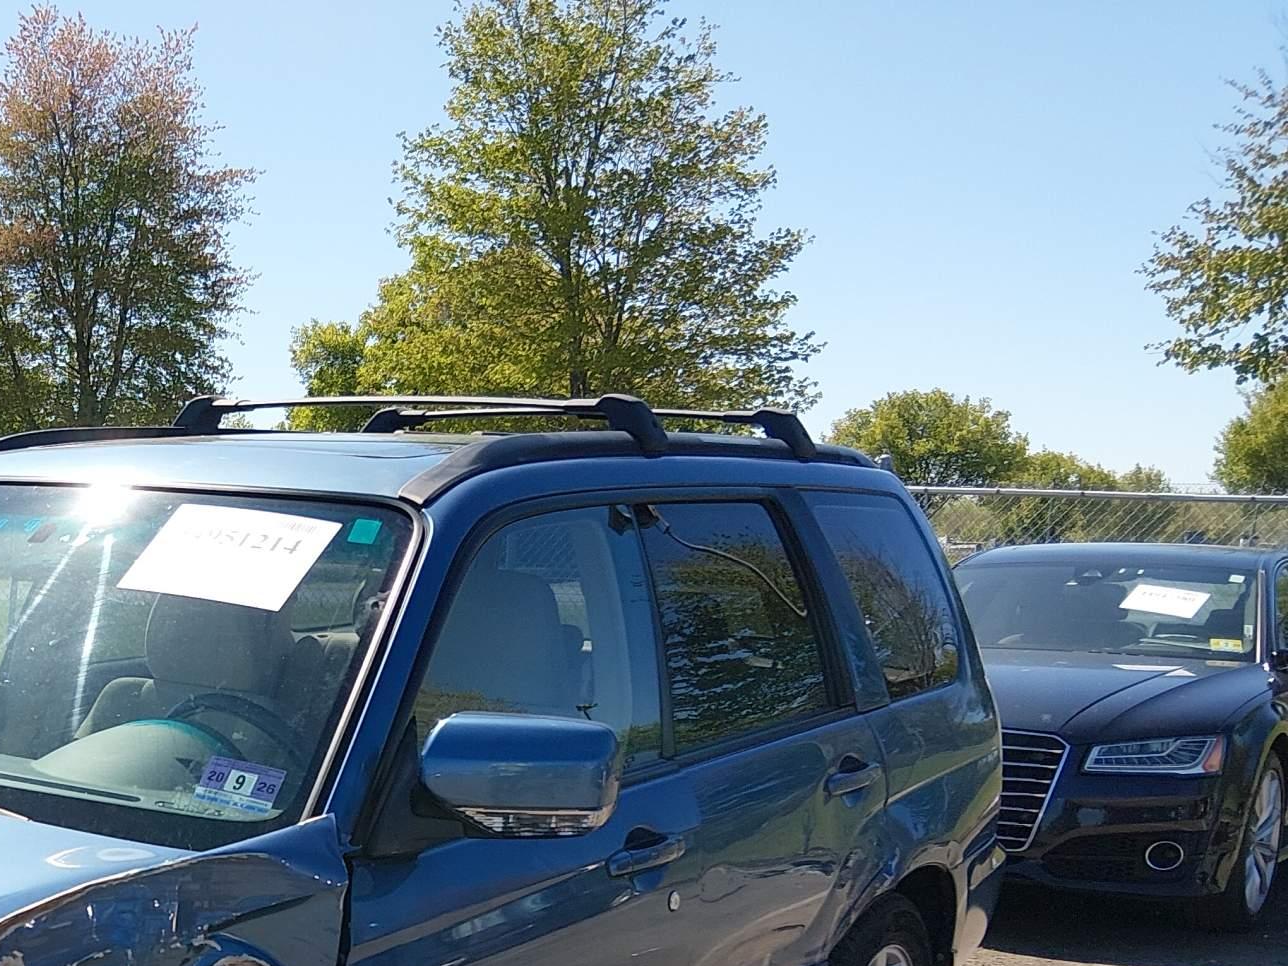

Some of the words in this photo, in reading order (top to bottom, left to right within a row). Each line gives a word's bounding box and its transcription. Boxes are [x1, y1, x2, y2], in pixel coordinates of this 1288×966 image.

[184, 527, 303, 555] 951214
[207, 770, 225, 783] 20
[232, 774, 246, 790] 9
[256, 782, 276, 794] 26
